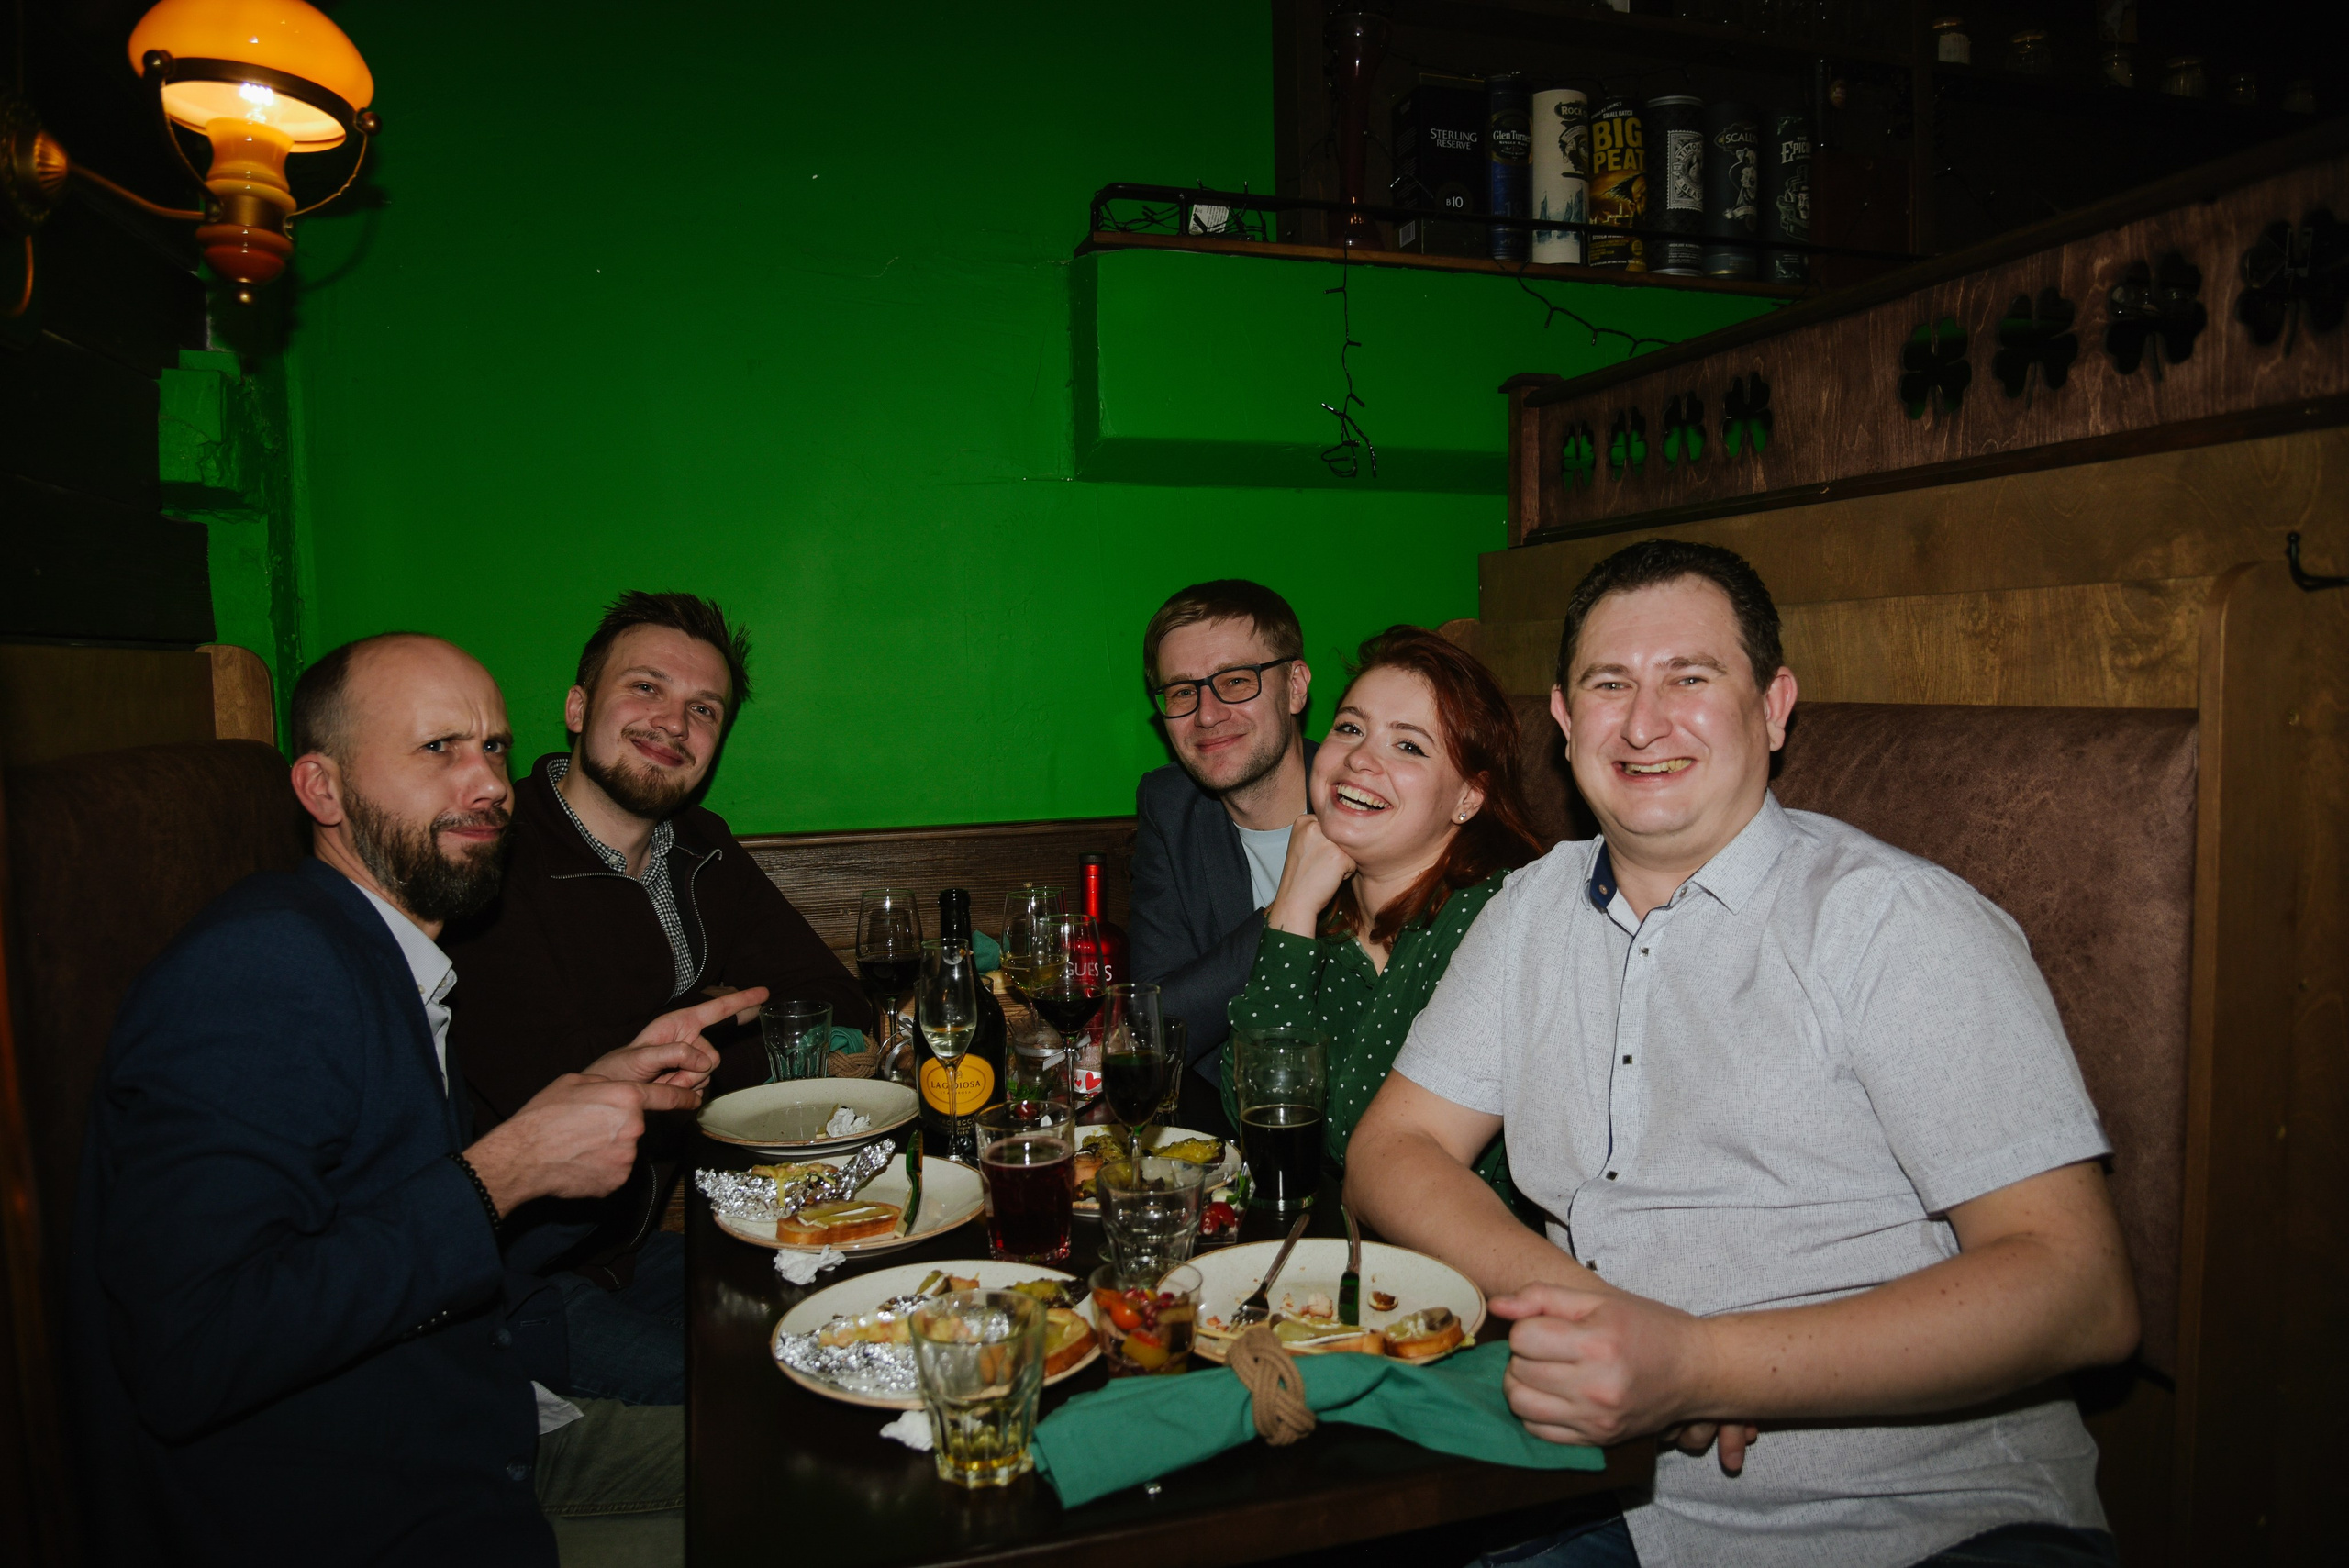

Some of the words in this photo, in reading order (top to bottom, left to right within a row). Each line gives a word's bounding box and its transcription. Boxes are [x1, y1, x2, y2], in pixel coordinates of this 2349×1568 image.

[1602, 110, 1618, 120] SMALL
[1430, 128, 1478, 143] STERLING
[1592, 117, 1642, 152] BIG
[1436, 139, 1472, 150] RESERVE
[1593, 148, 1645, 174] PEAT
